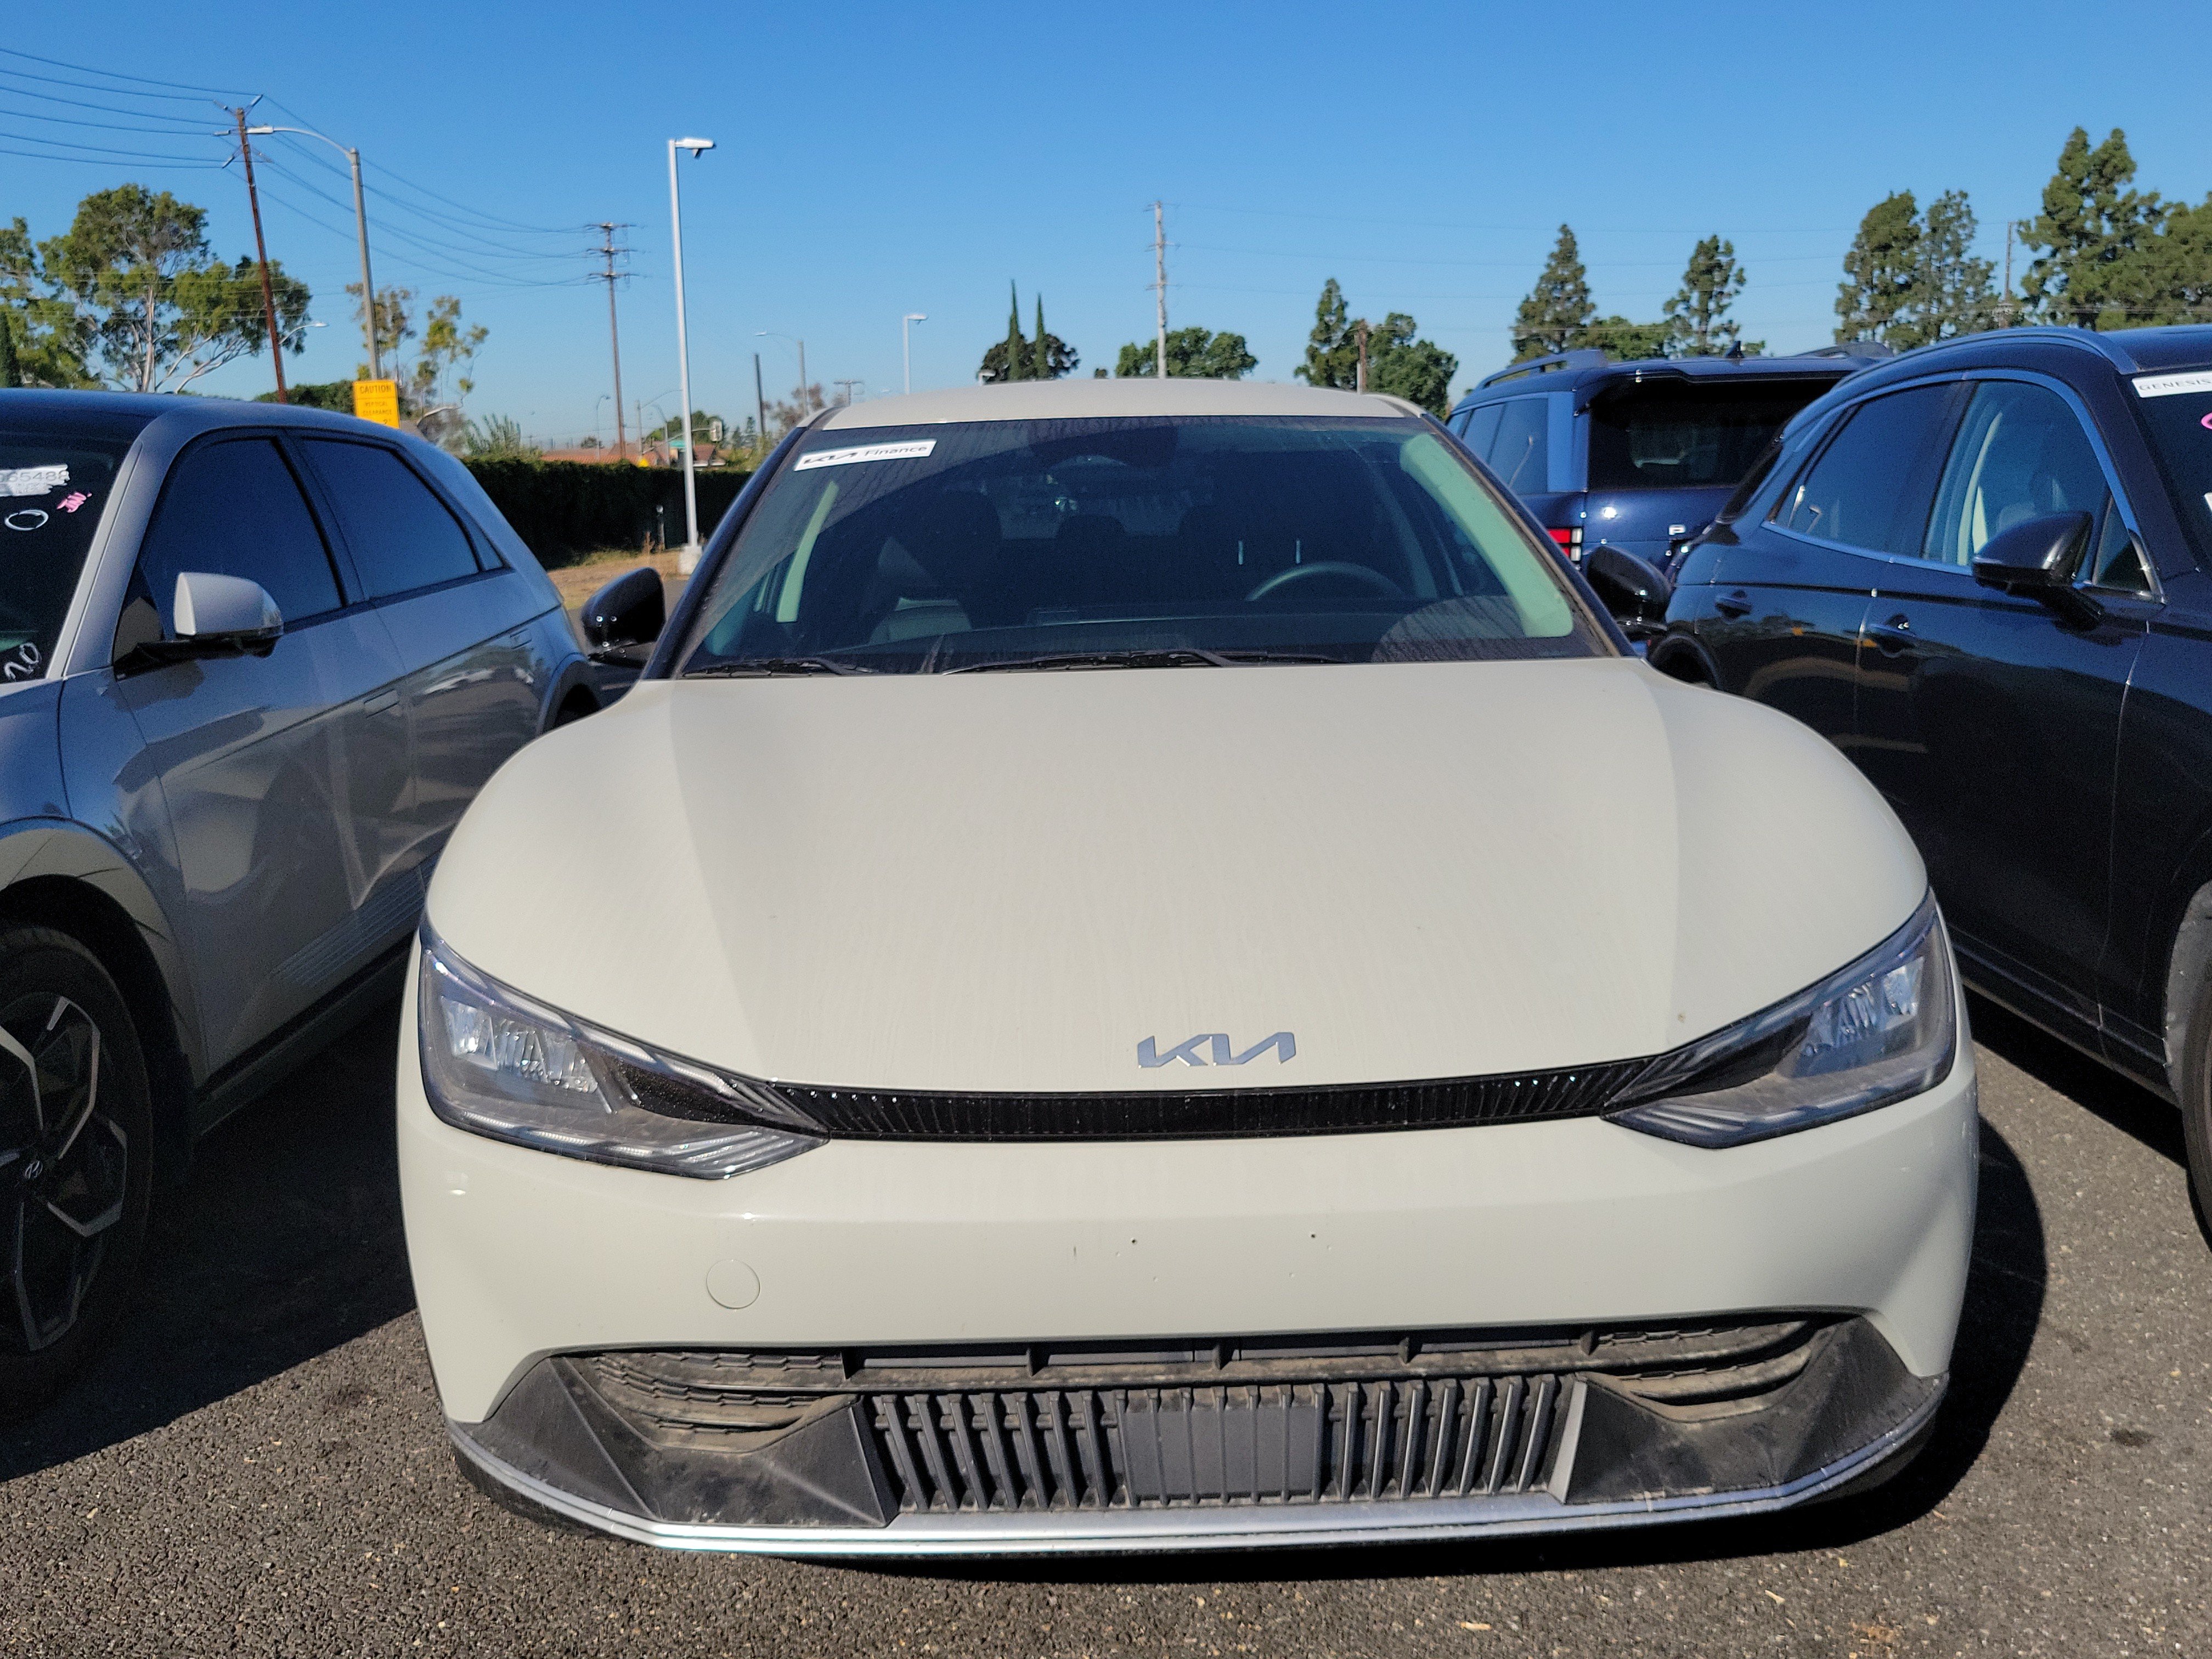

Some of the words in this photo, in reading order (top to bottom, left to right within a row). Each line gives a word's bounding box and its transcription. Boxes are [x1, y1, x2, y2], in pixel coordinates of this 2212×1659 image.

[360, 385, 392, 394] CAUTION
[2139, 379, 2212, 391] GENESIS
[803, 452, 858, 465] KIA
[864, 446, 927, 456] Finance
[1138, 1032, 1296, 1068] KIA
